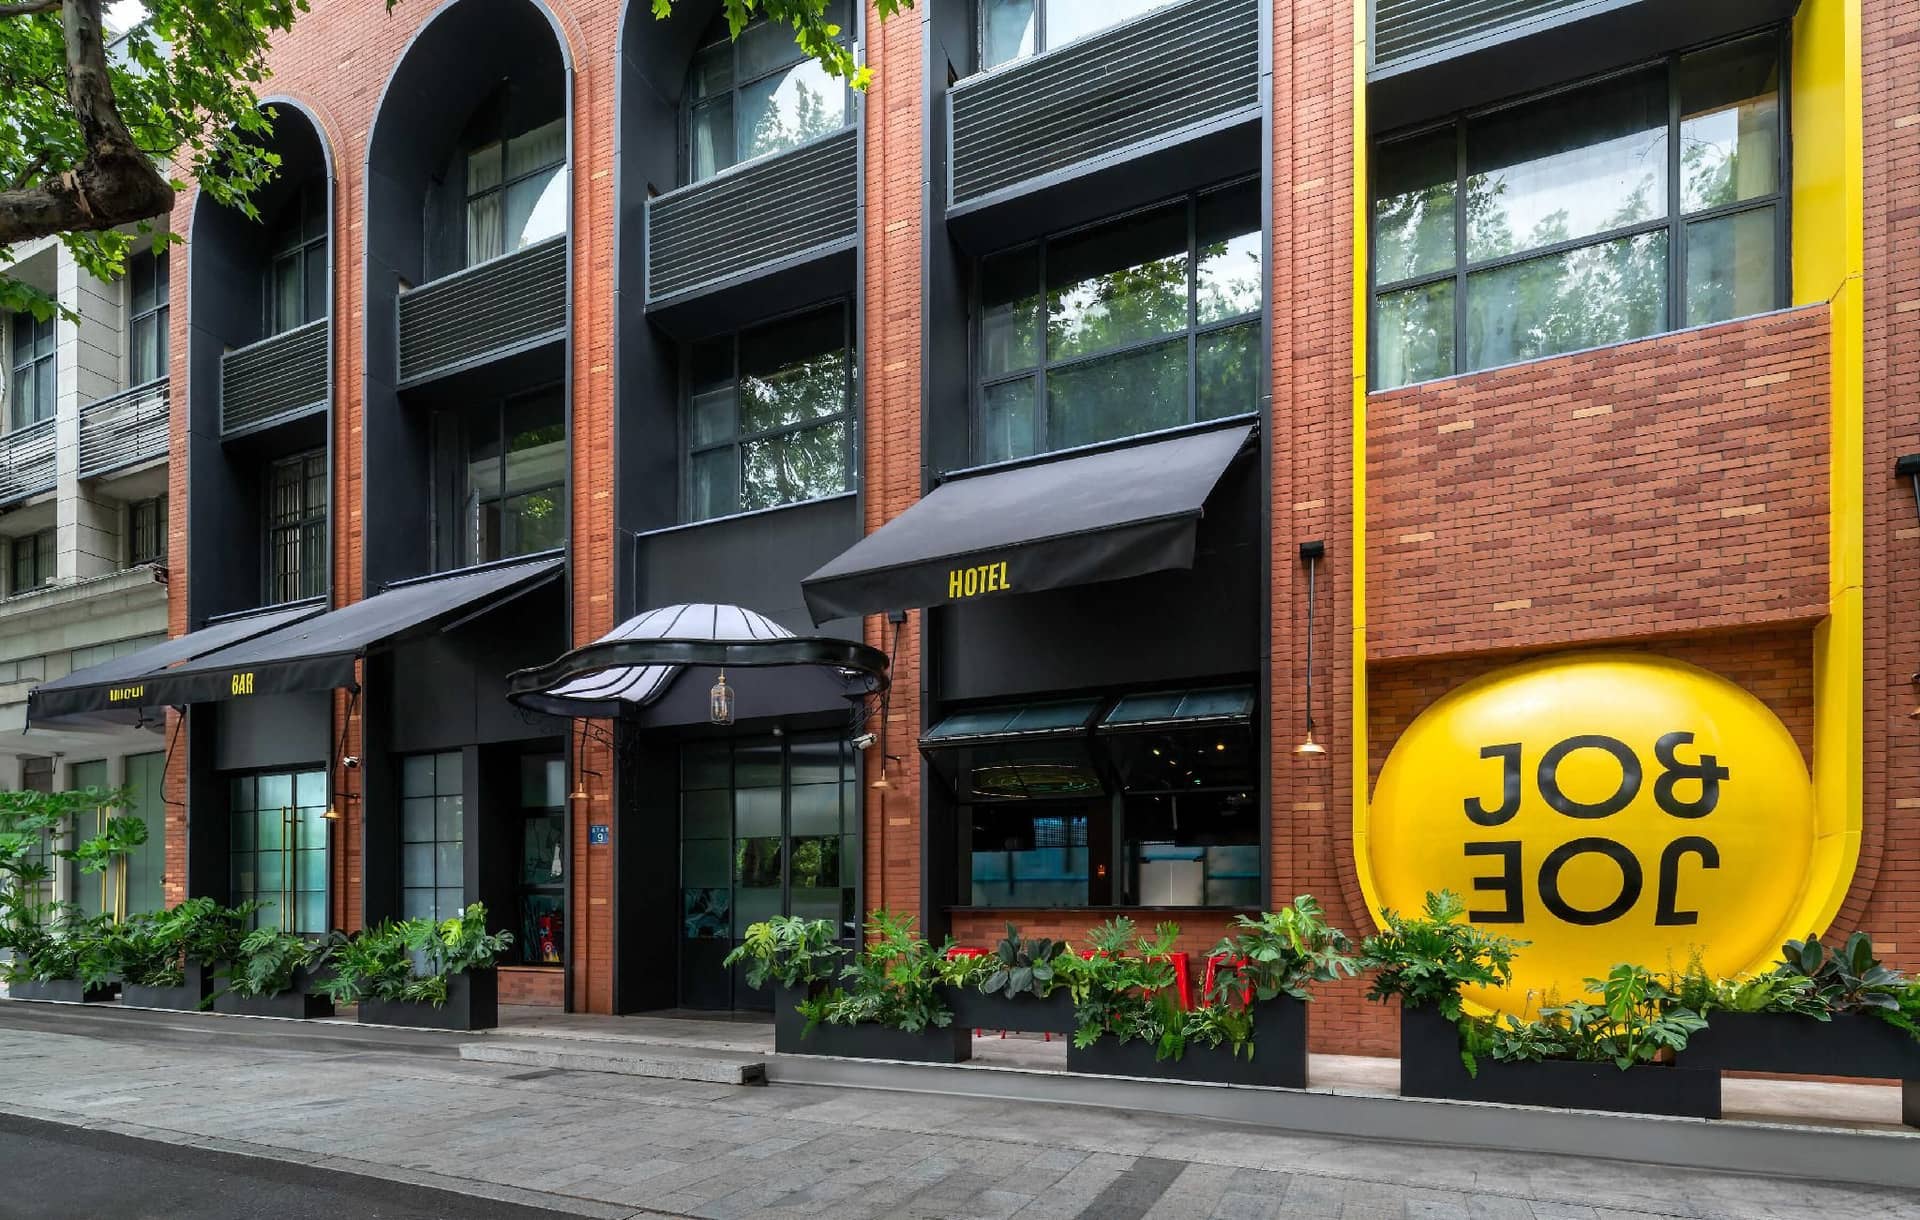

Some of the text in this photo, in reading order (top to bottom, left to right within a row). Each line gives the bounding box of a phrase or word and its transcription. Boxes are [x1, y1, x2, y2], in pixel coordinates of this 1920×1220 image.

[948, 561, 1010, 598] HOTEL
[231, 673, 254, 695] BAR
[1464, 732, 1729, 826] JO&
[597, 833, 604, 842] 9
[1464, 836, 1720, 926] JOE
